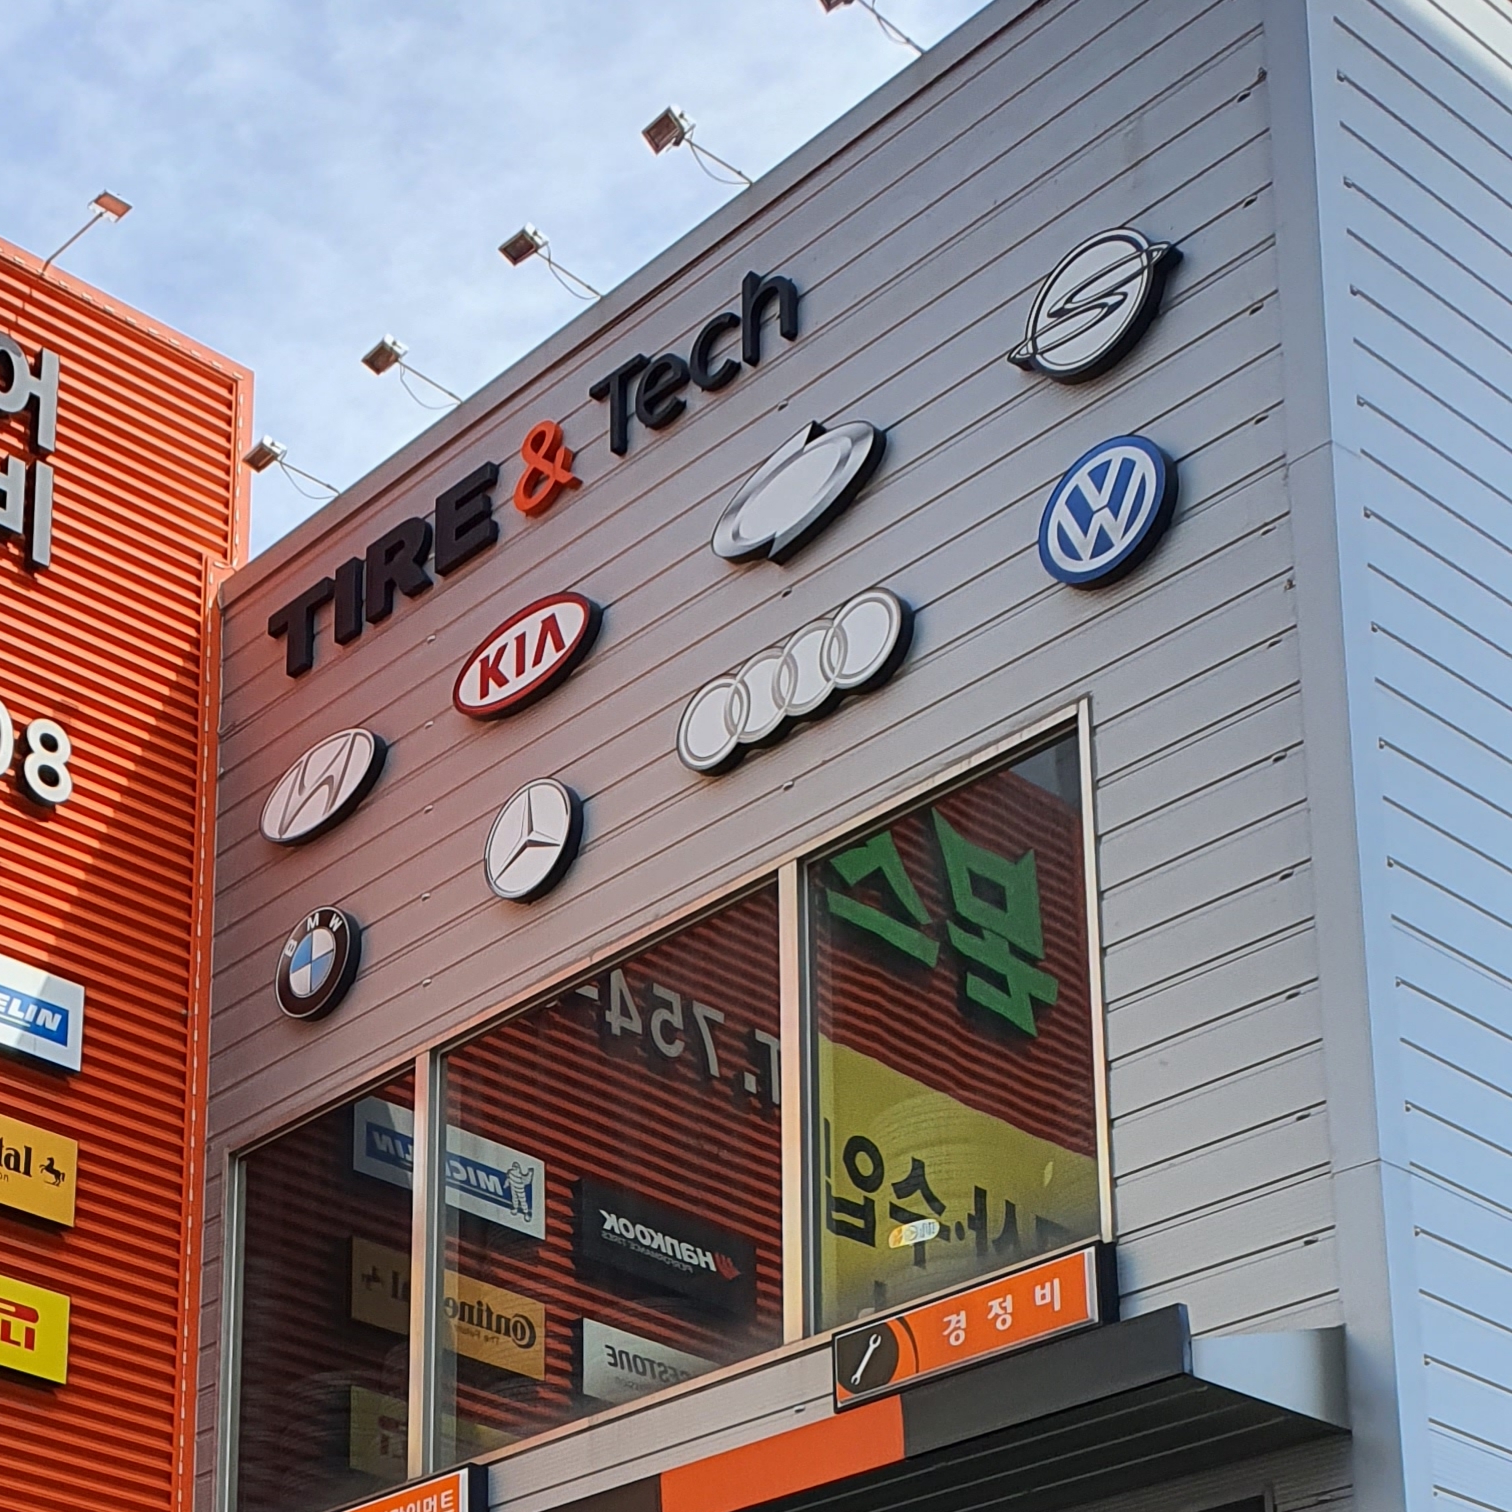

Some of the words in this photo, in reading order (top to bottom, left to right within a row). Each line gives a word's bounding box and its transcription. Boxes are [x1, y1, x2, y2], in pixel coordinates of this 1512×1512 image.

[267, 461, 499, 679] TIRE
[513, 419, 583, 518] &
[589, 270, 800, 456] Tech
[476, 610, 568, 704] KIA
[284, 912, 343, 957] BMW
